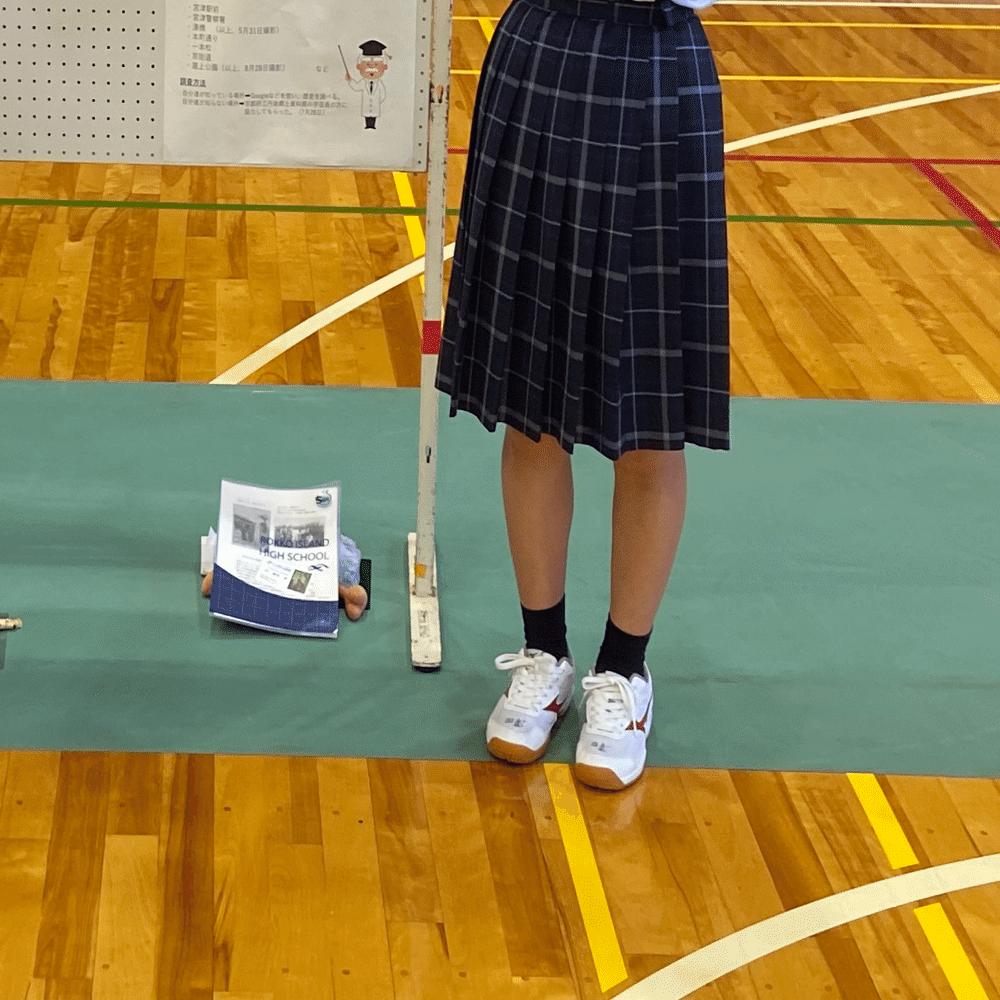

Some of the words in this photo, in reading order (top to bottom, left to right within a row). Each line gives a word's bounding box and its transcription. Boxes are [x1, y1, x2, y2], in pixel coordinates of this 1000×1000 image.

[179, 77, 206, 88] 調査方法
[260, 535, 293, 548] ROKKO
[295, 538, 330, 548] ISLAND
[259, 548, 285, 561] HIGH
[287, 551, 330, 561] SCHOOL
